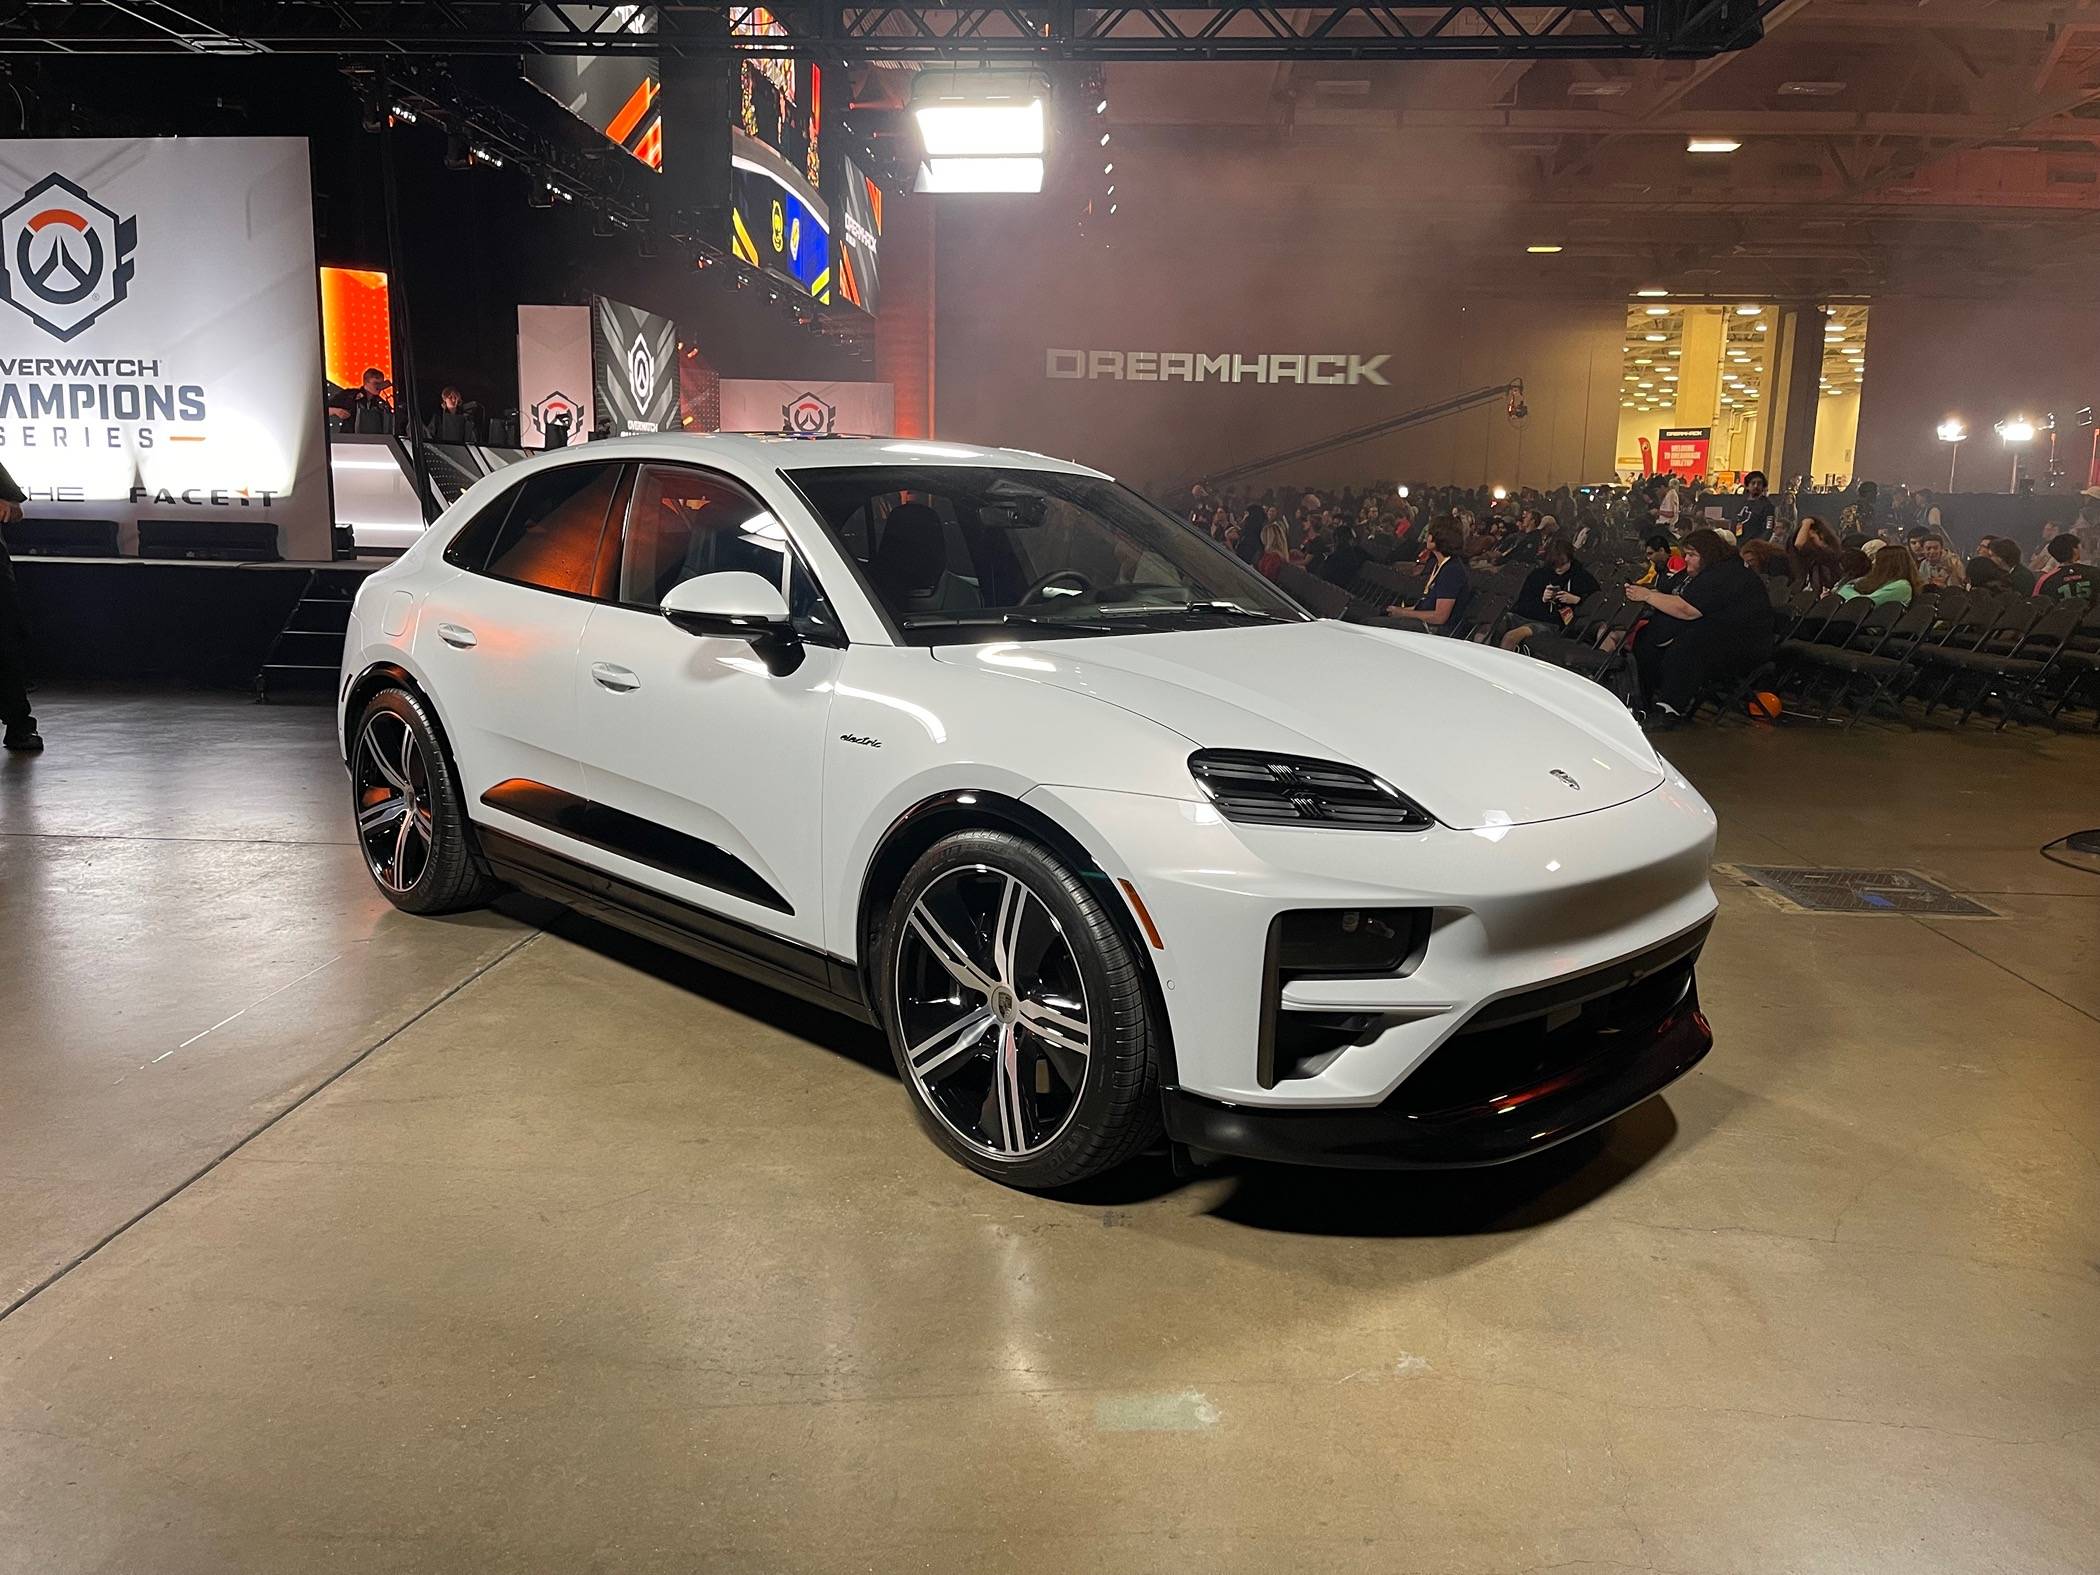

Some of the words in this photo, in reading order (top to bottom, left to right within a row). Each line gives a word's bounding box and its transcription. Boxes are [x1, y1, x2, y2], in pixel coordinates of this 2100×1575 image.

[1046, 348, 1392, 385] DREAMHACK
[20, 486, 85, 502] HE
[129, 486, 278, 507] FACEIT
[839, 733, 882, 748] electric
